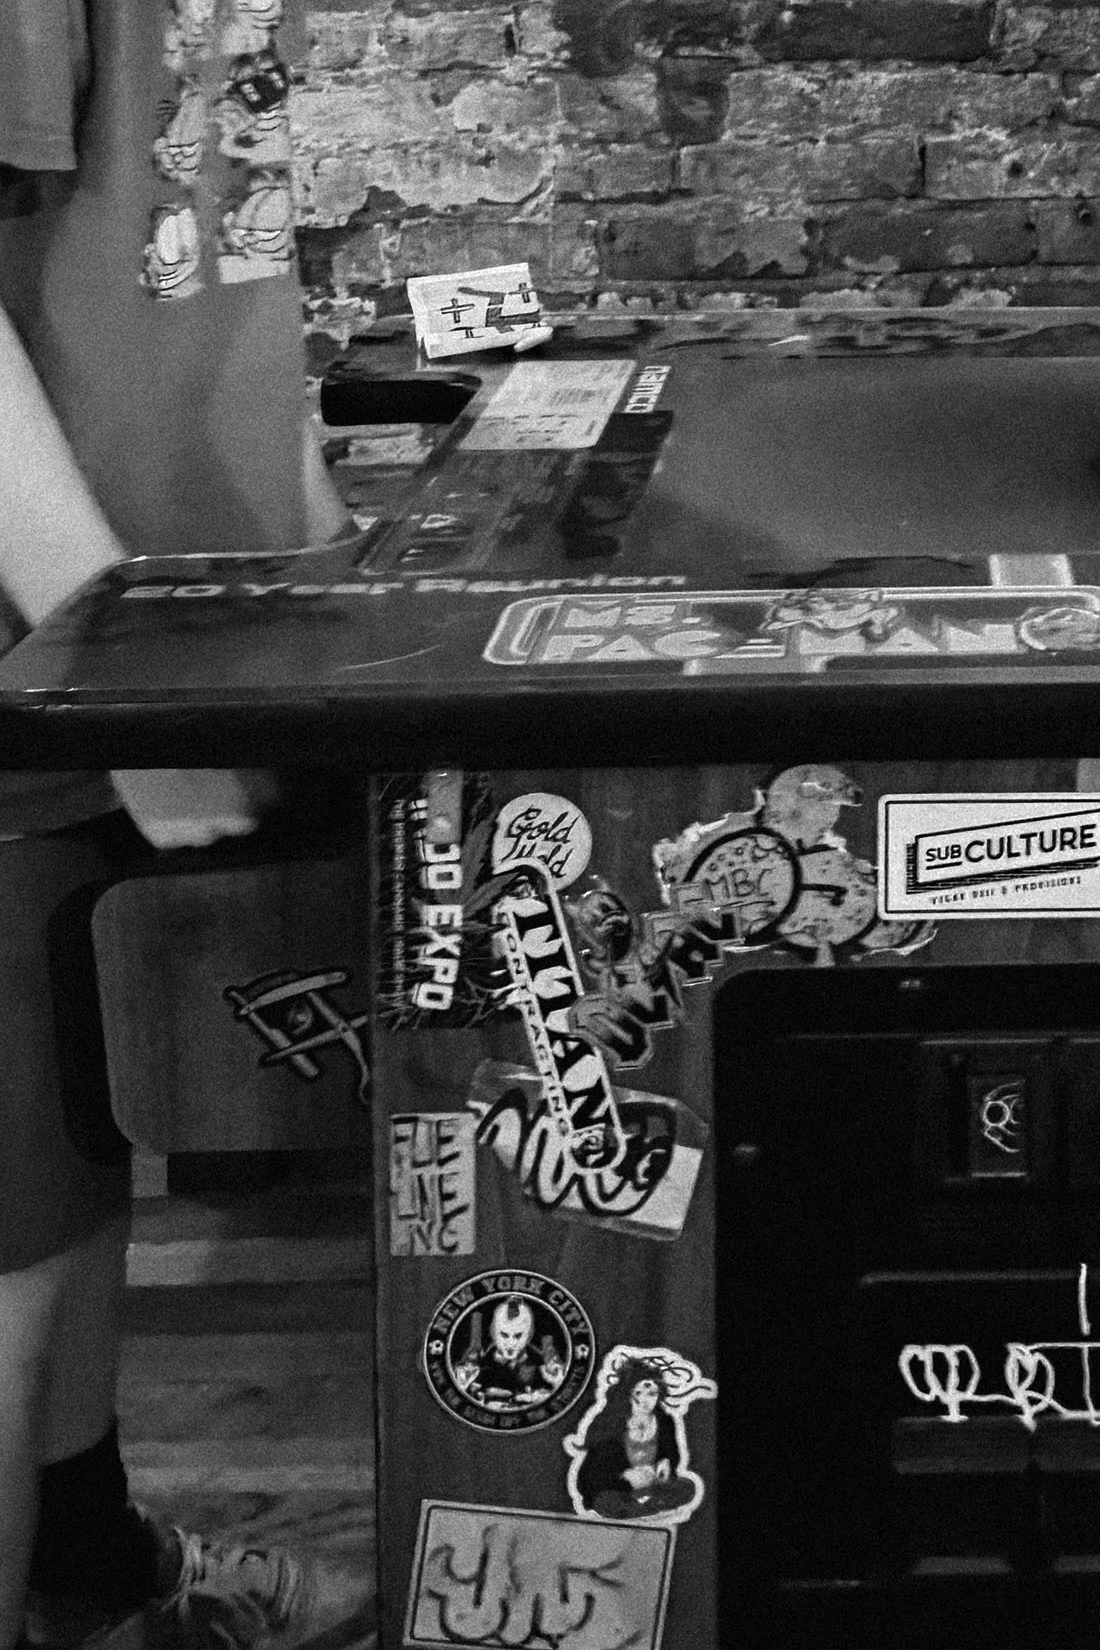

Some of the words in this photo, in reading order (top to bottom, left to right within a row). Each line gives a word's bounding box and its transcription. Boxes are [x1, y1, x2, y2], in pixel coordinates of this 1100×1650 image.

[416, 905, 464, 1011] EXPO
[481, 1275, 546, 1295] YORK
[548, 1290, 590, 1335] CITY
